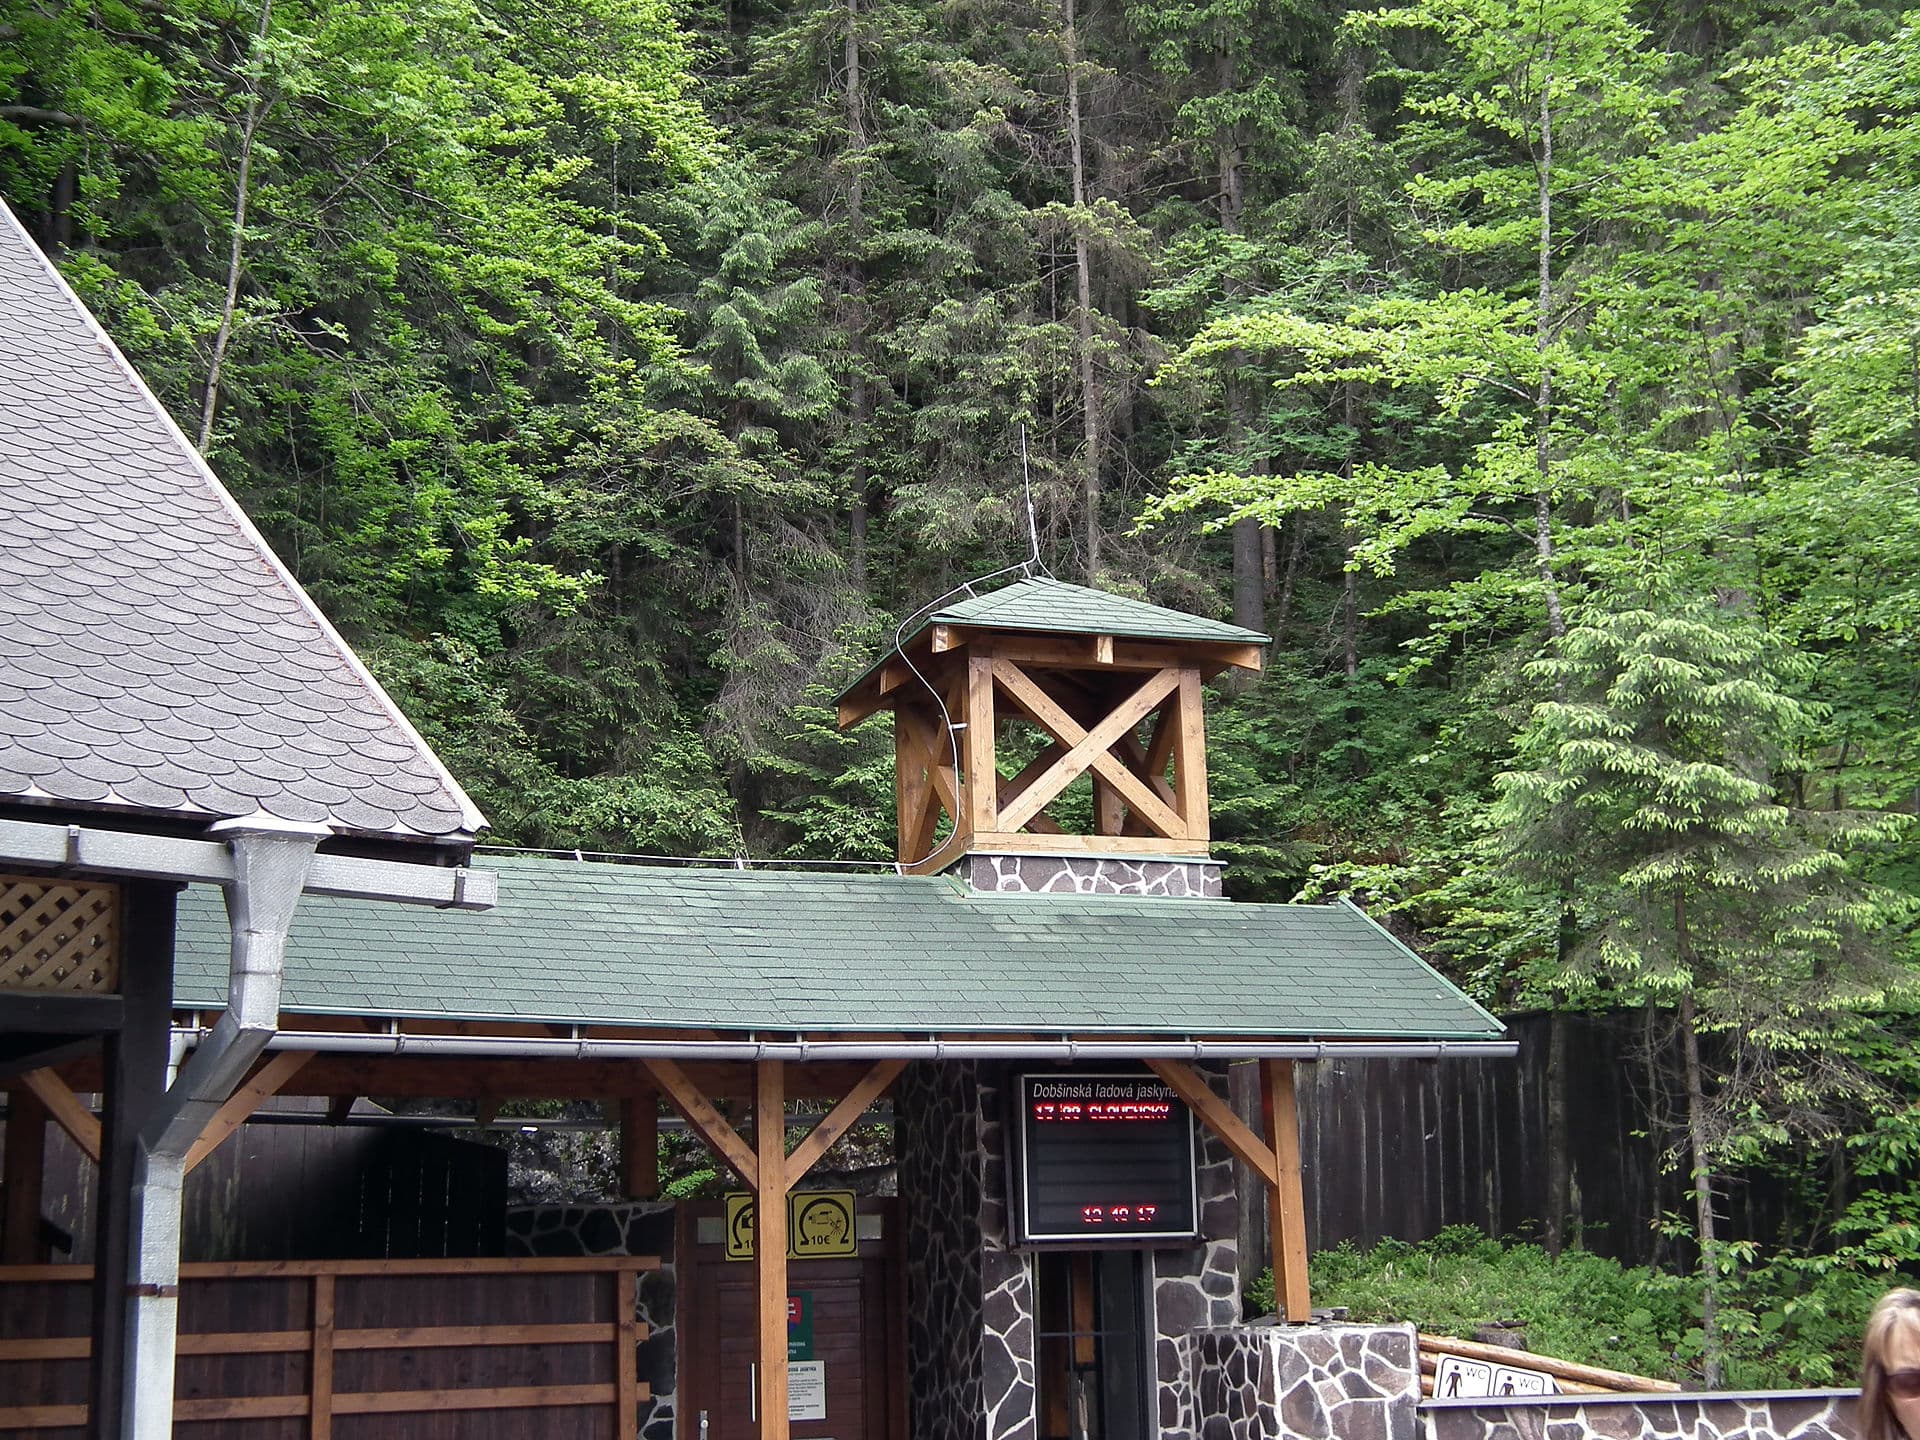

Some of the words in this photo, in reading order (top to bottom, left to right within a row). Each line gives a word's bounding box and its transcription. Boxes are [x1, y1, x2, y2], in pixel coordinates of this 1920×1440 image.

[1033, 1083, 1092, 1099] Dobšinská
[1095, 1083, 1133, 1099] ľadová
[811, 1235, 830, 1245] 10€
[1466, 1366, 1486, 1380] WC
[1520, 1378, 1539, 1391] WC
